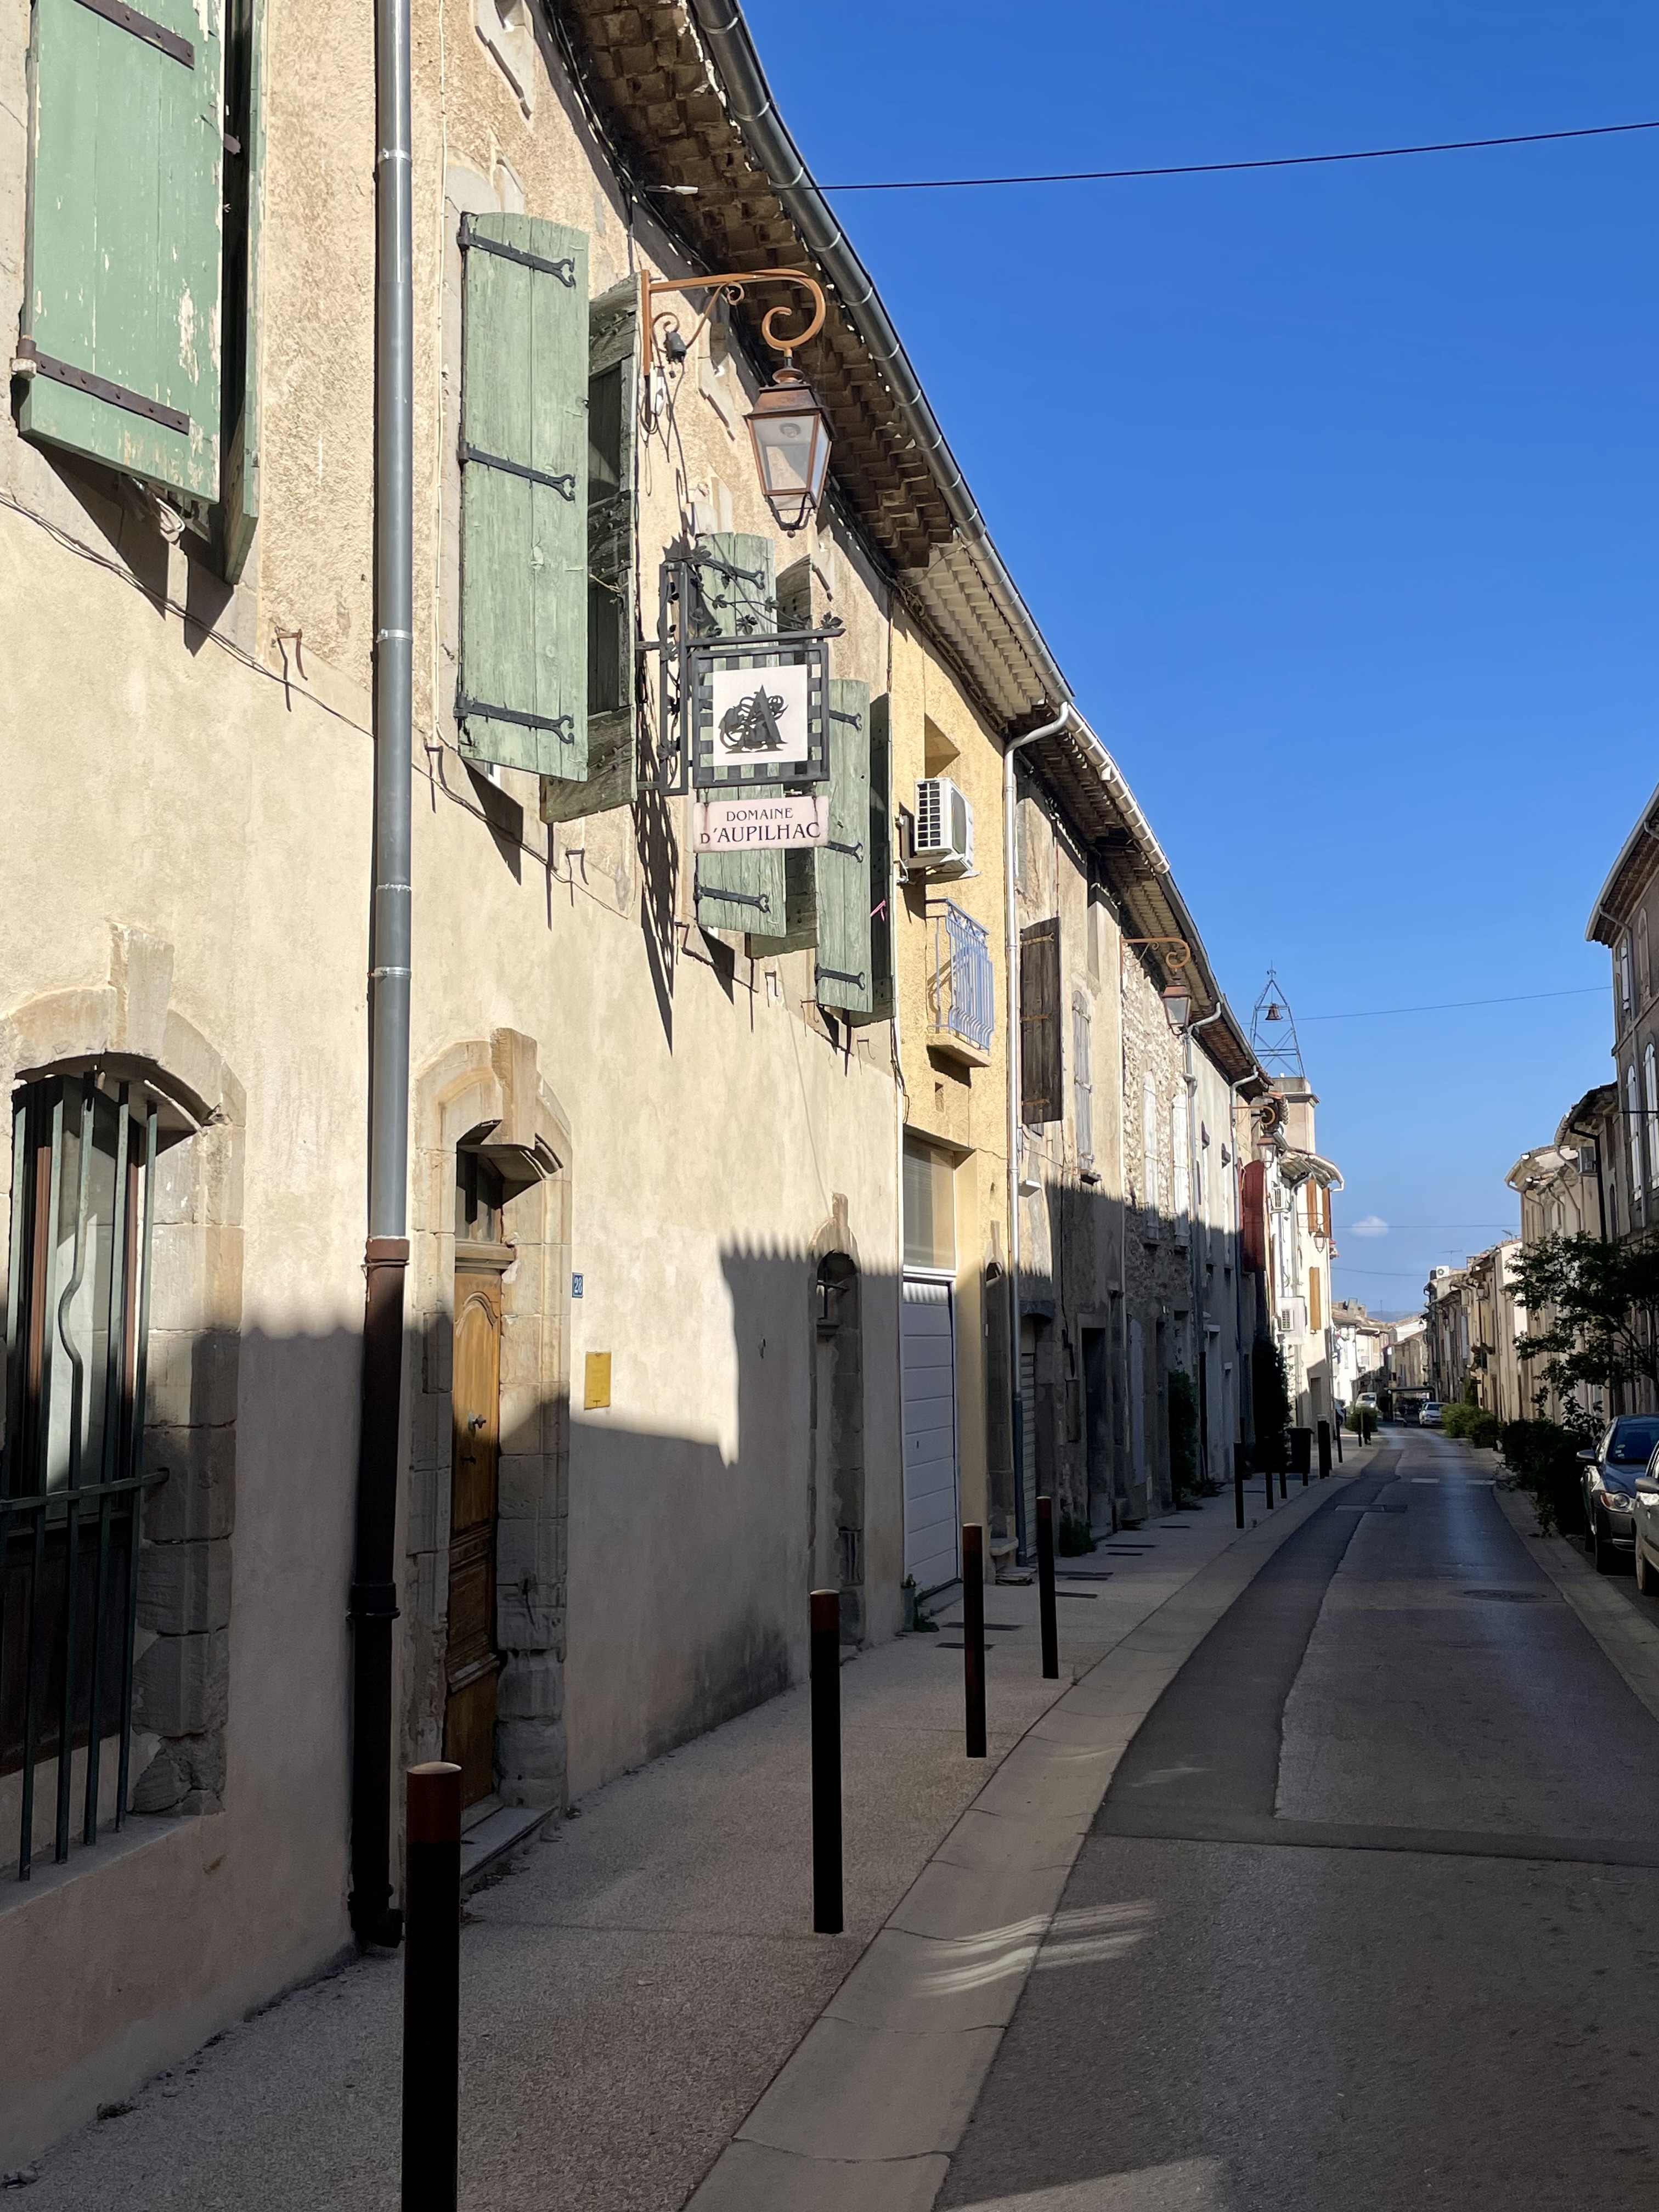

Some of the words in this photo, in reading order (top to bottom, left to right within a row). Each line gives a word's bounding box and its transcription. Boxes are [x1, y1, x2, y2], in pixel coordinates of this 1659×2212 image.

[726, 808, 793, 822] DOMAINE
[700, 822, 821, 844] D'AUPILHAC
[574, 1277, 582, 1294] 28
